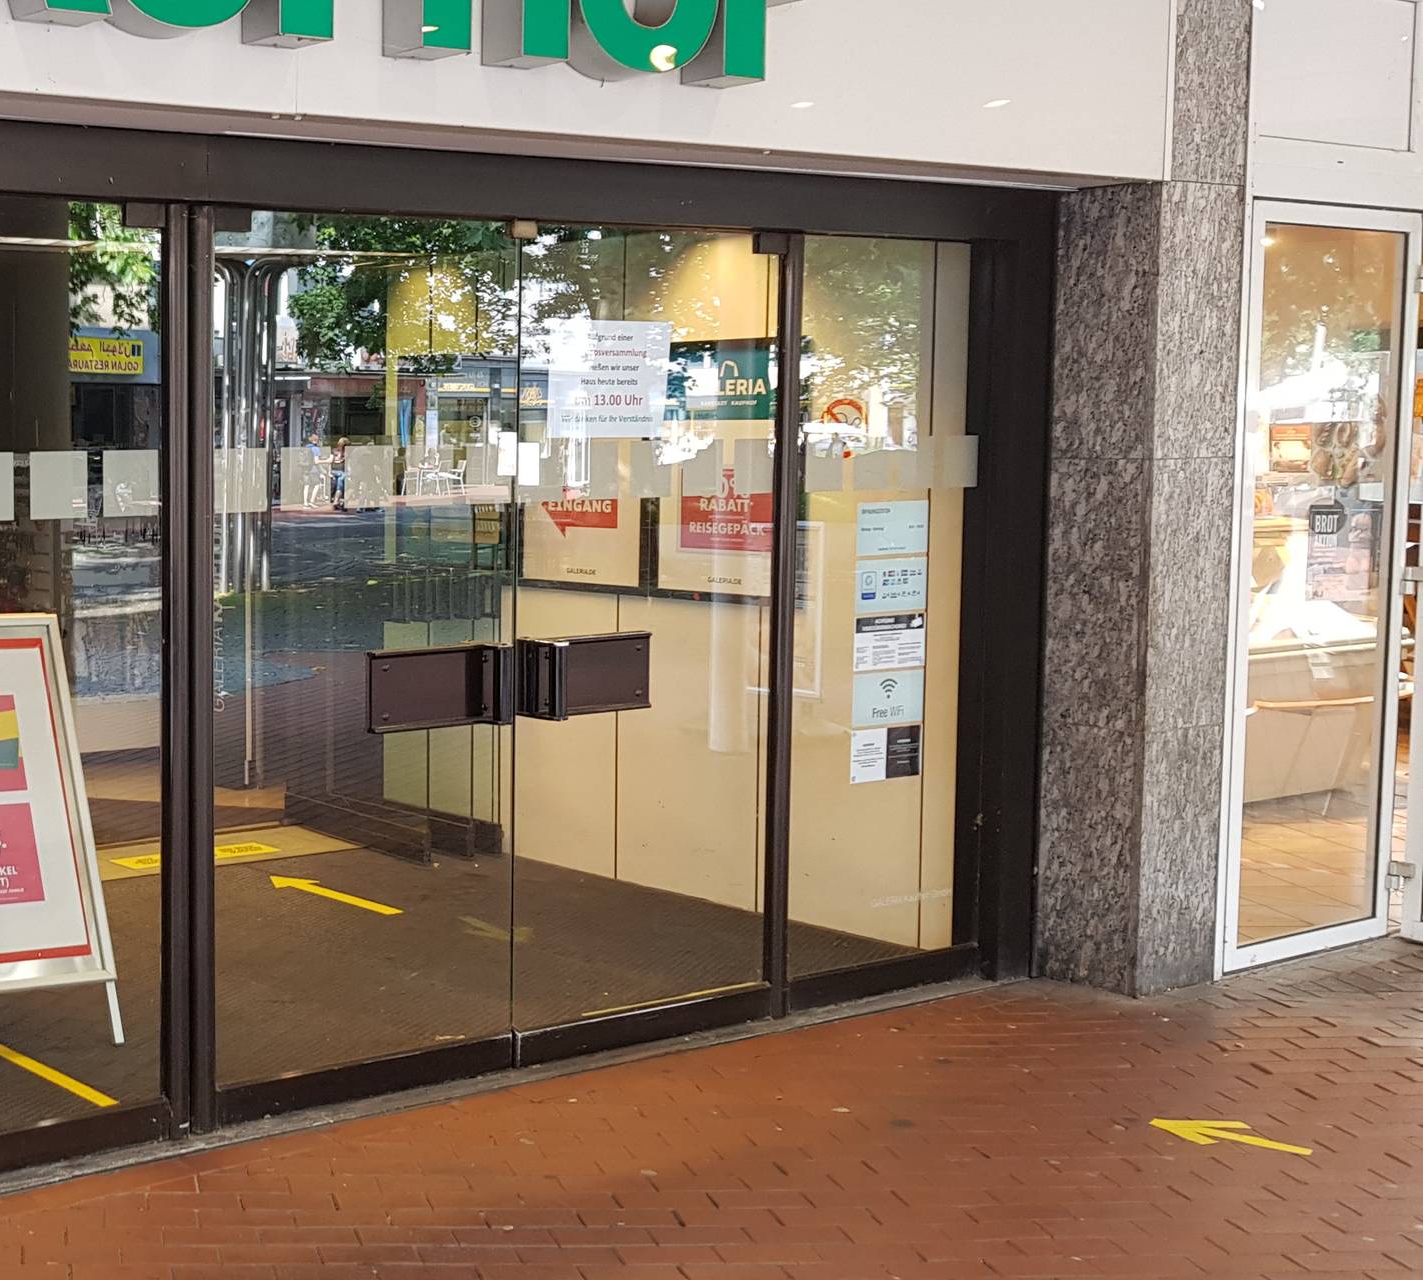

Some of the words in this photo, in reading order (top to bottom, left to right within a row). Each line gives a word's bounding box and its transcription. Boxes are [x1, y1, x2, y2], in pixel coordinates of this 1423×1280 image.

[594, 394, 622, 406] 13.00
[624, 394, 643, 406] Uhr
[547, 498, 612, 514] EINGANG
[1314, 514, 1340, 533] BROT
[872, 707, 888, 719] Free
[890, 705, 905, 717] WiFi
